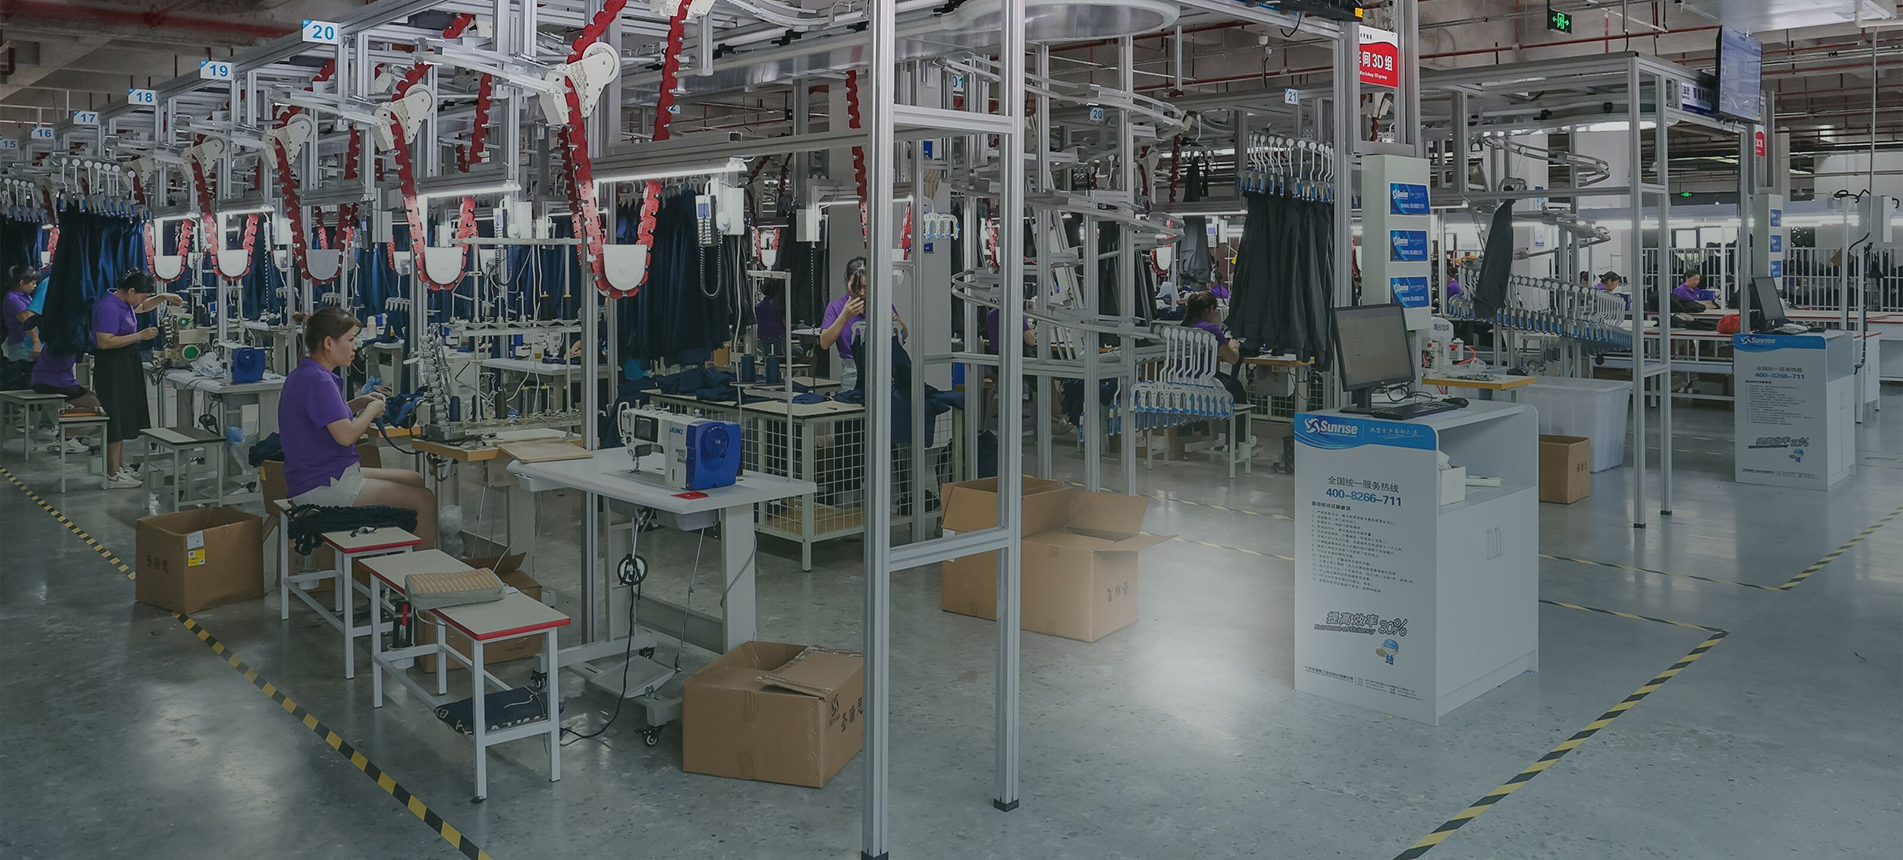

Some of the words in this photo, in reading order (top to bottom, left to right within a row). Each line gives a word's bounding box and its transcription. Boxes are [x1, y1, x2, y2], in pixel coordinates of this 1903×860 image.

[312, 24, 335, 41] 20
[209, 64, 229, 77] 19
[135, 91, 153, 104] 18
[1288, 91, 1297, 102] 21
[80, 113, 96, 123] 17
[1093, 109, 1103, 119] 20
[37, 129, 51, 138] 16
[3, 140, 16, 149] 15
[1750, 336, 1776, 345] Sunrise
[669, 426, 683, 435] JUKI
[1320, 420, 1358, 435] Sunrise
[1327, 476, 1400, 493] 全国统一服务热线
[1325, 488, 1402, 507] 400-8266-711
[1326, 611, 1379, 627] 提高效率
[1378, 618, 1408, 637] 30%
